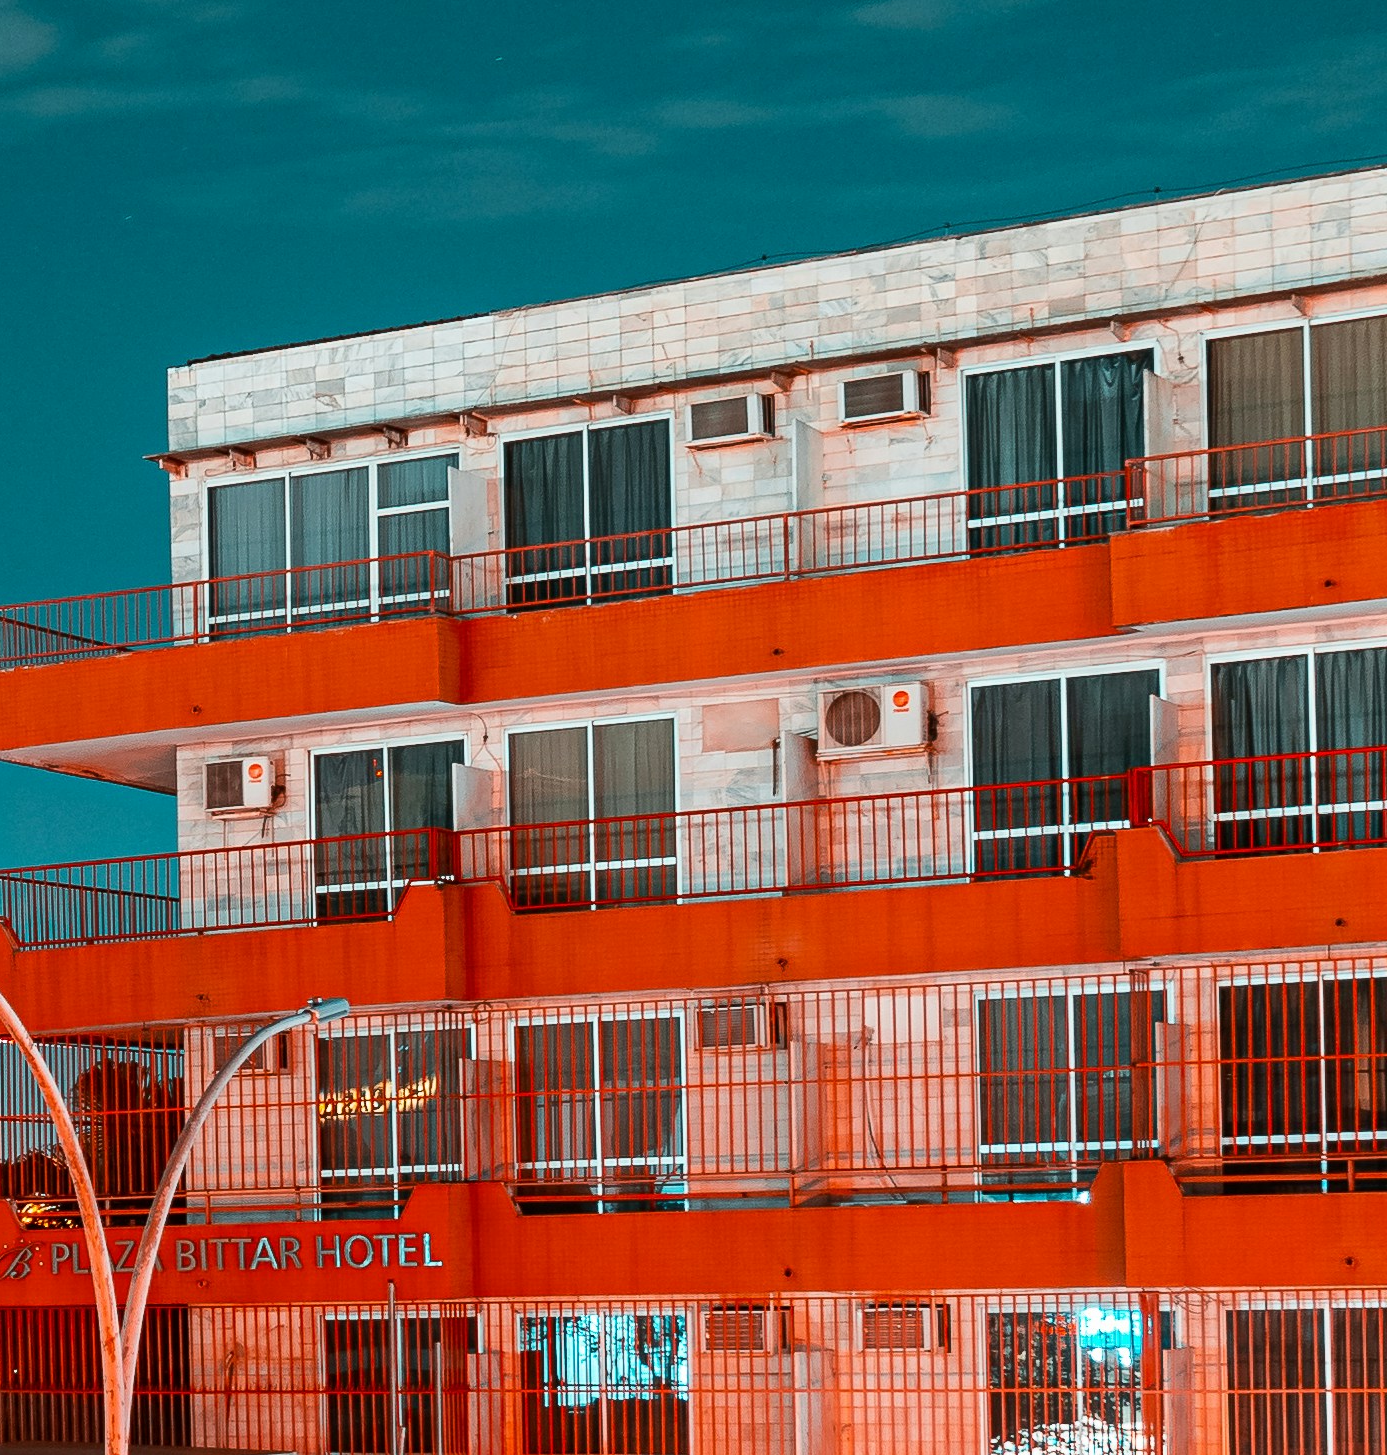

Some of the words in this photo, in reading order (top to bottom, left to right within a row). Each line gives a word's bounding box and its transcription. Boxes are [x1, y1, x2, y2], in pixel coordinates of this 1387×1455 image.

[51, 1240, 163, 1275] PLZ
[175, 1236, 302, 1272] BITTAR
[315, 1232, 444, 1269] HOTEL
